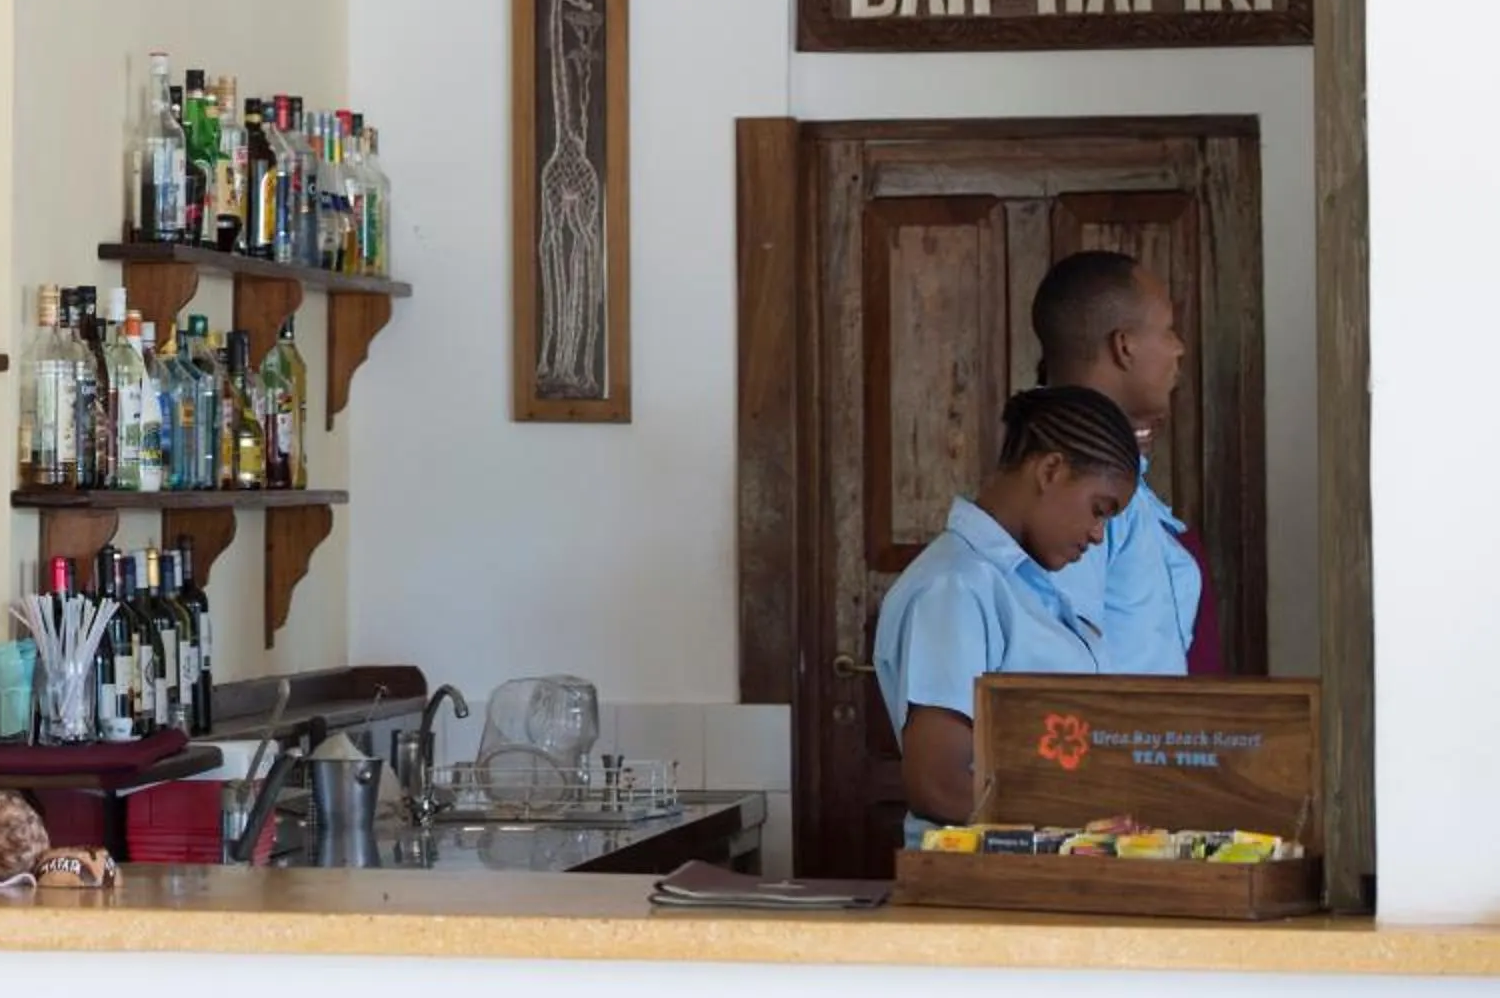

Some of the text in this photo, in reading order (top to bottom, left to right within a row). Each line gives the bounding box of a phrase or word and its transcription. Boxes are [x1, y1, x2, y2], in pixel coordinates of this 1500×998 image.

[1132, 730, 1162, 749] Bay
[1165, 730, 1207, 745] Beach
[1213, 731, 1263, 747] Resort
[1133, 749, 1219, 766] TEA TIME
